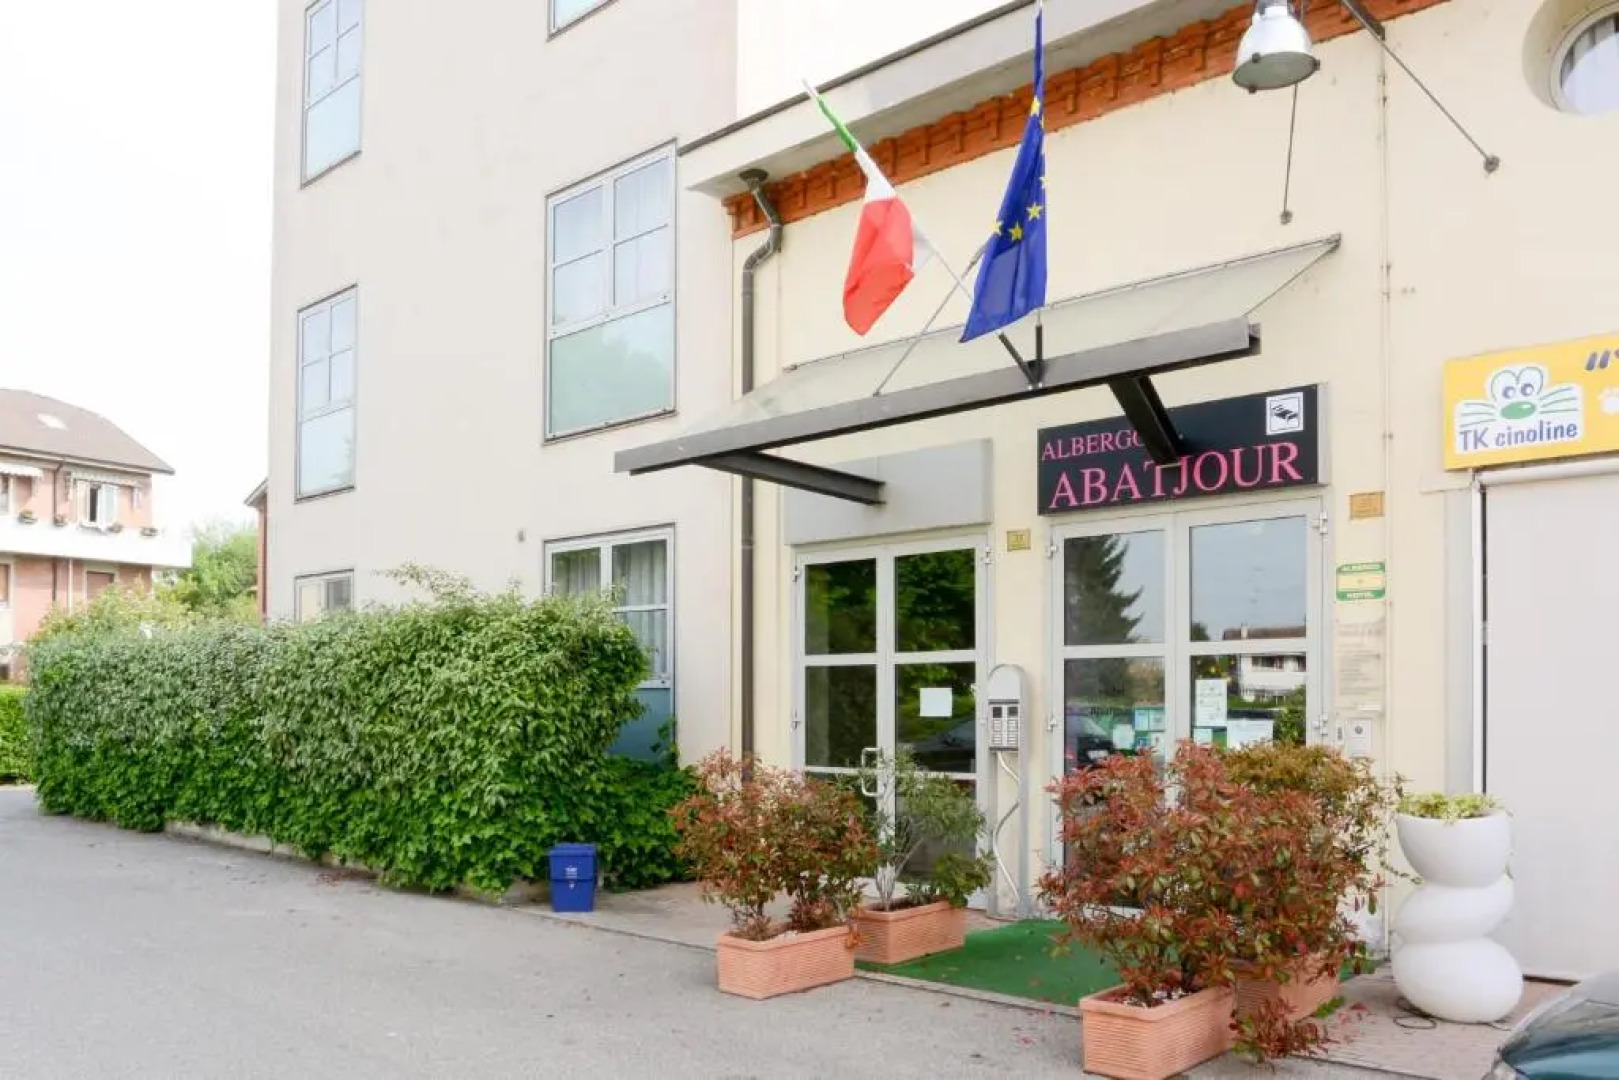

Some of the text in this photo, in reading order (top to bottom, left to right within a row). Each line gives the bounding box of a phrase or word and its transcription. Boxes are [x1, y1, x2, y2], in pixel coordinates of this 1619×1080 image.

[1459, 419, 1578, 451] TK cinoline
[1049, 442, 1303, 509] ABATJOUR
